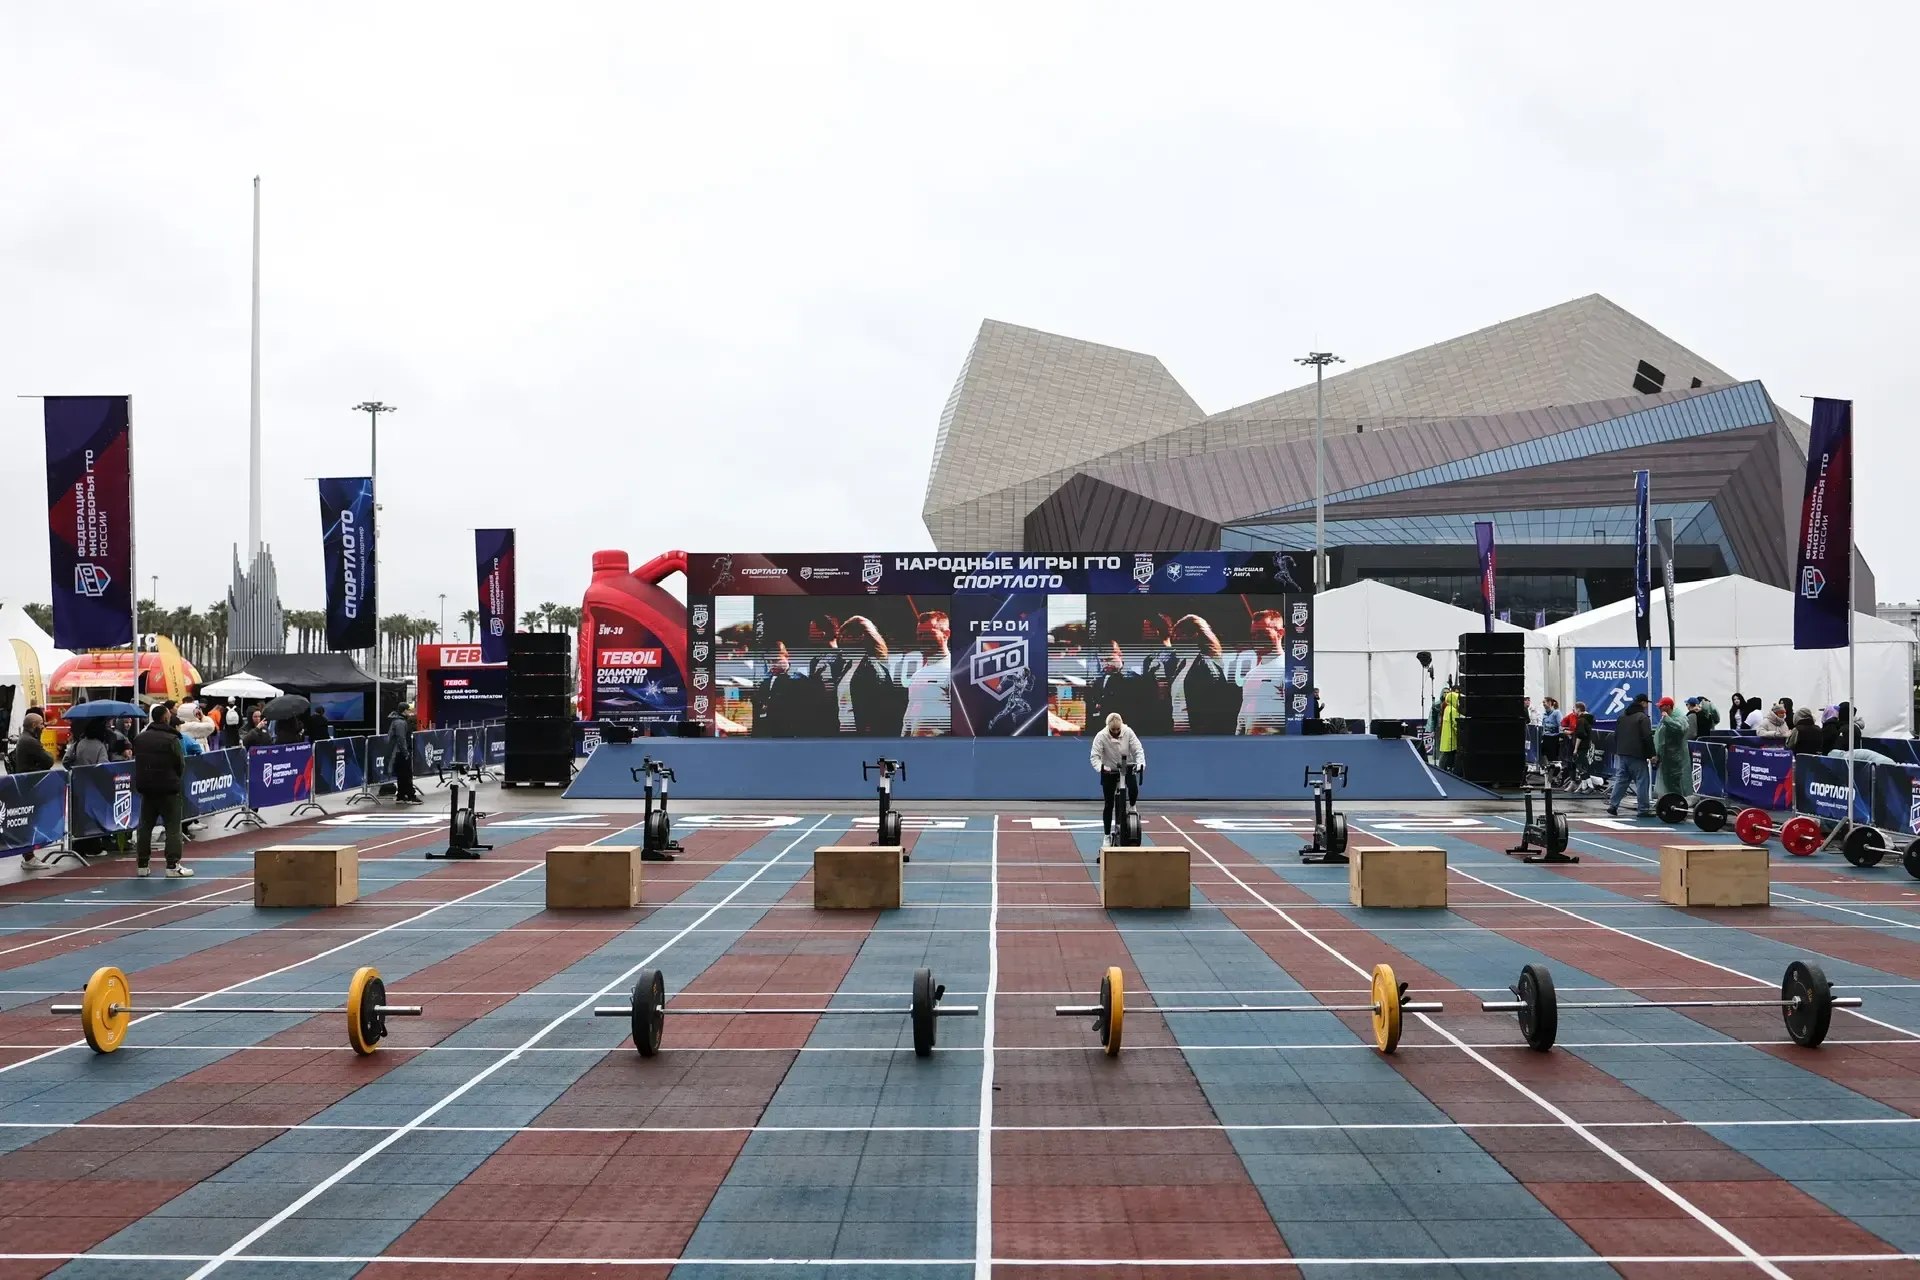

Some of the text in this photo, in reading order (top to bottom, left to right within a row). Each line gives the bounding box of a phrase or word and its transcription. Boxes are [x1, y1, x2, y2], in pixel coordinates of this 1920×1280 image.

[85, 449, 97, 557] МНОГОБОРЬЯ ГТО
[1812, 453, 1829, 560] МНОГОБОРЬЯ ГТО
[76, 482, 86, 557] ФЕДЕРАЦИЯ
[1806, 486, 1818, 559] ФЕДЕРАЦИЯ
[99, 511, 108, 557] РОССИИ
[1819, 515, 1829, 559] РОССИИ
[340, 509, 357, 619] СПОРТЛОТО
[895, 556, 1121, 573] НАРОДНЫЕ ИГРЫ ГТО
[1137, 566, 1151, 576] ГТО
[865, 567, 880, 577] ГТО
[82, 567, 98, 593] ГТО
[953, 575, 1063, 589] СПОРТЛОТО
[1806, 570, 1815, 594] ГТО
[970, 620, 1029, 631] ГЕРОИ
[446, 649, 481, 663] TEB
[601, 651, 657, 665] TEBOIL
[978, 649, 1021, 677] ГТО
[1592, 660, 1644, 669] МУЖСКАЯ
[597, 668, 648, 677] DIAMOND
[597, 676, 644, 684] CARAT III
[115, 782, 131, 790] ИГРЫ
[191, 774, 232, 795] СПОРТЛОТО
[6, 805, 35, 817] МИНСПОРТ
[115, 799, 130, 817] ГТО
[6, 817, 29, 828] РОССИИ
[1358, 818, 1502, 831] 2
